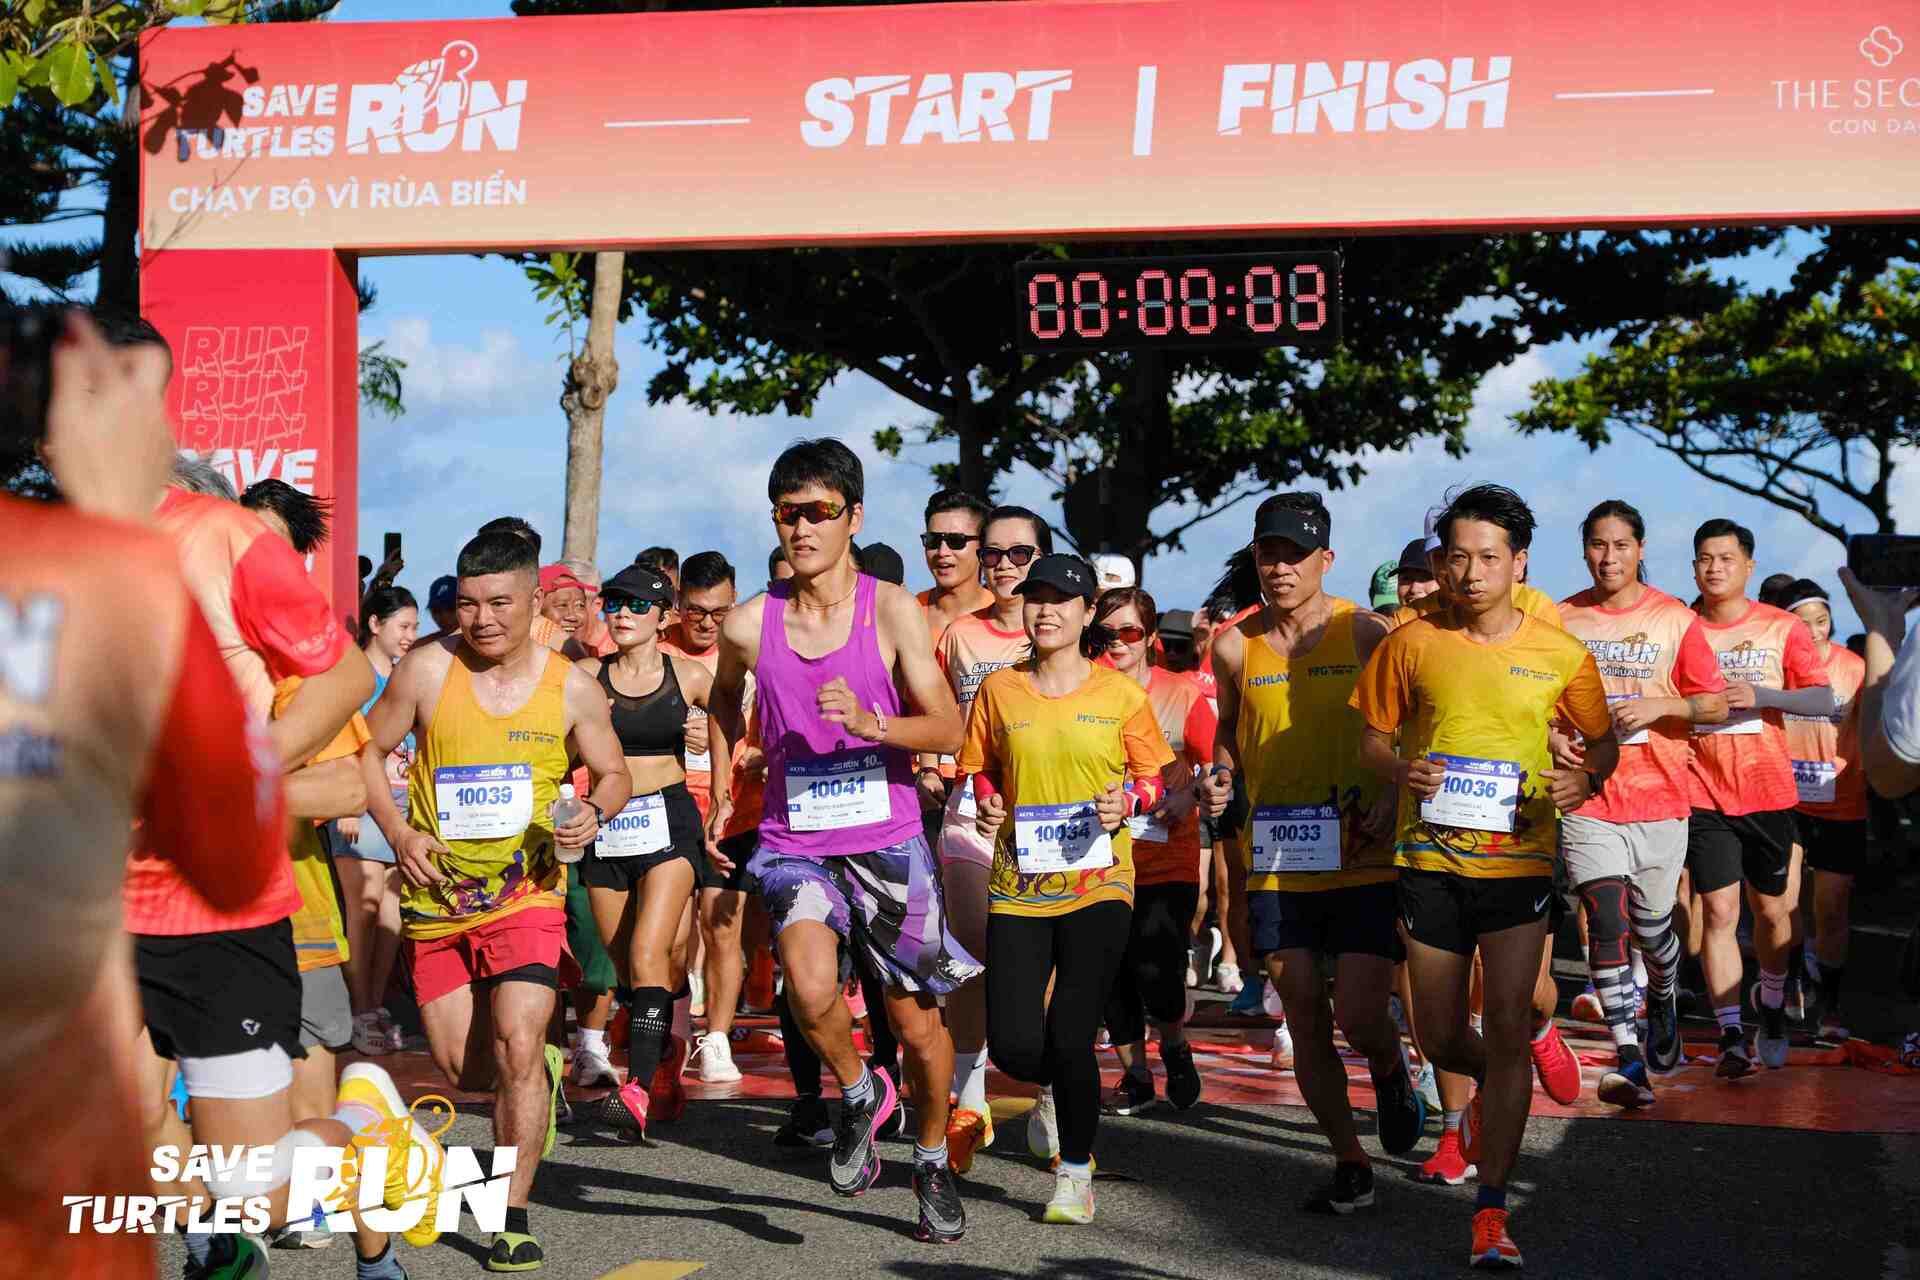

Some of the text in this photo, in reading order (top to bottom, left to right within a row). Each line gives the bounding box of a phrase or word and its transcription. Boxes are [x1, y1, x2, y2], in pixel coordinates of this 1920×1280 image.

[243, 83, 338, 118] SAVE
[800, 70, 1073, 147] START
[1216, 56, 1512, 135] FINISH
[1771, 78, 1920, 112] THE SEC
[346, 79, 528, 155] RUN
[1829, 119, 1877, 135] CON
[175, 125, 336, 160] TURTLES
[169, 168, 528, 217] CHẠY BỘ VÌ RÙA BIỂN
[1028, 264, 1326, 339] 00:00:03
[182, 327, 309, 377] RUN
[181, 370, 307, 421] RUN
[177, 449, 317, 495] AVE
[1607, 641, 1660, 663] RUN
[1718, 650, 1766, 668] RUN
[456, 786, 513, 806] 10039
[808, 775, 865, 799] 10041
[1443, 776, 1498, 799] 10036
[608, 814, 650, 832] 10006
[1034, 821, 1090, 842] 10034
[1269, 824, 1321, 842] 10033
